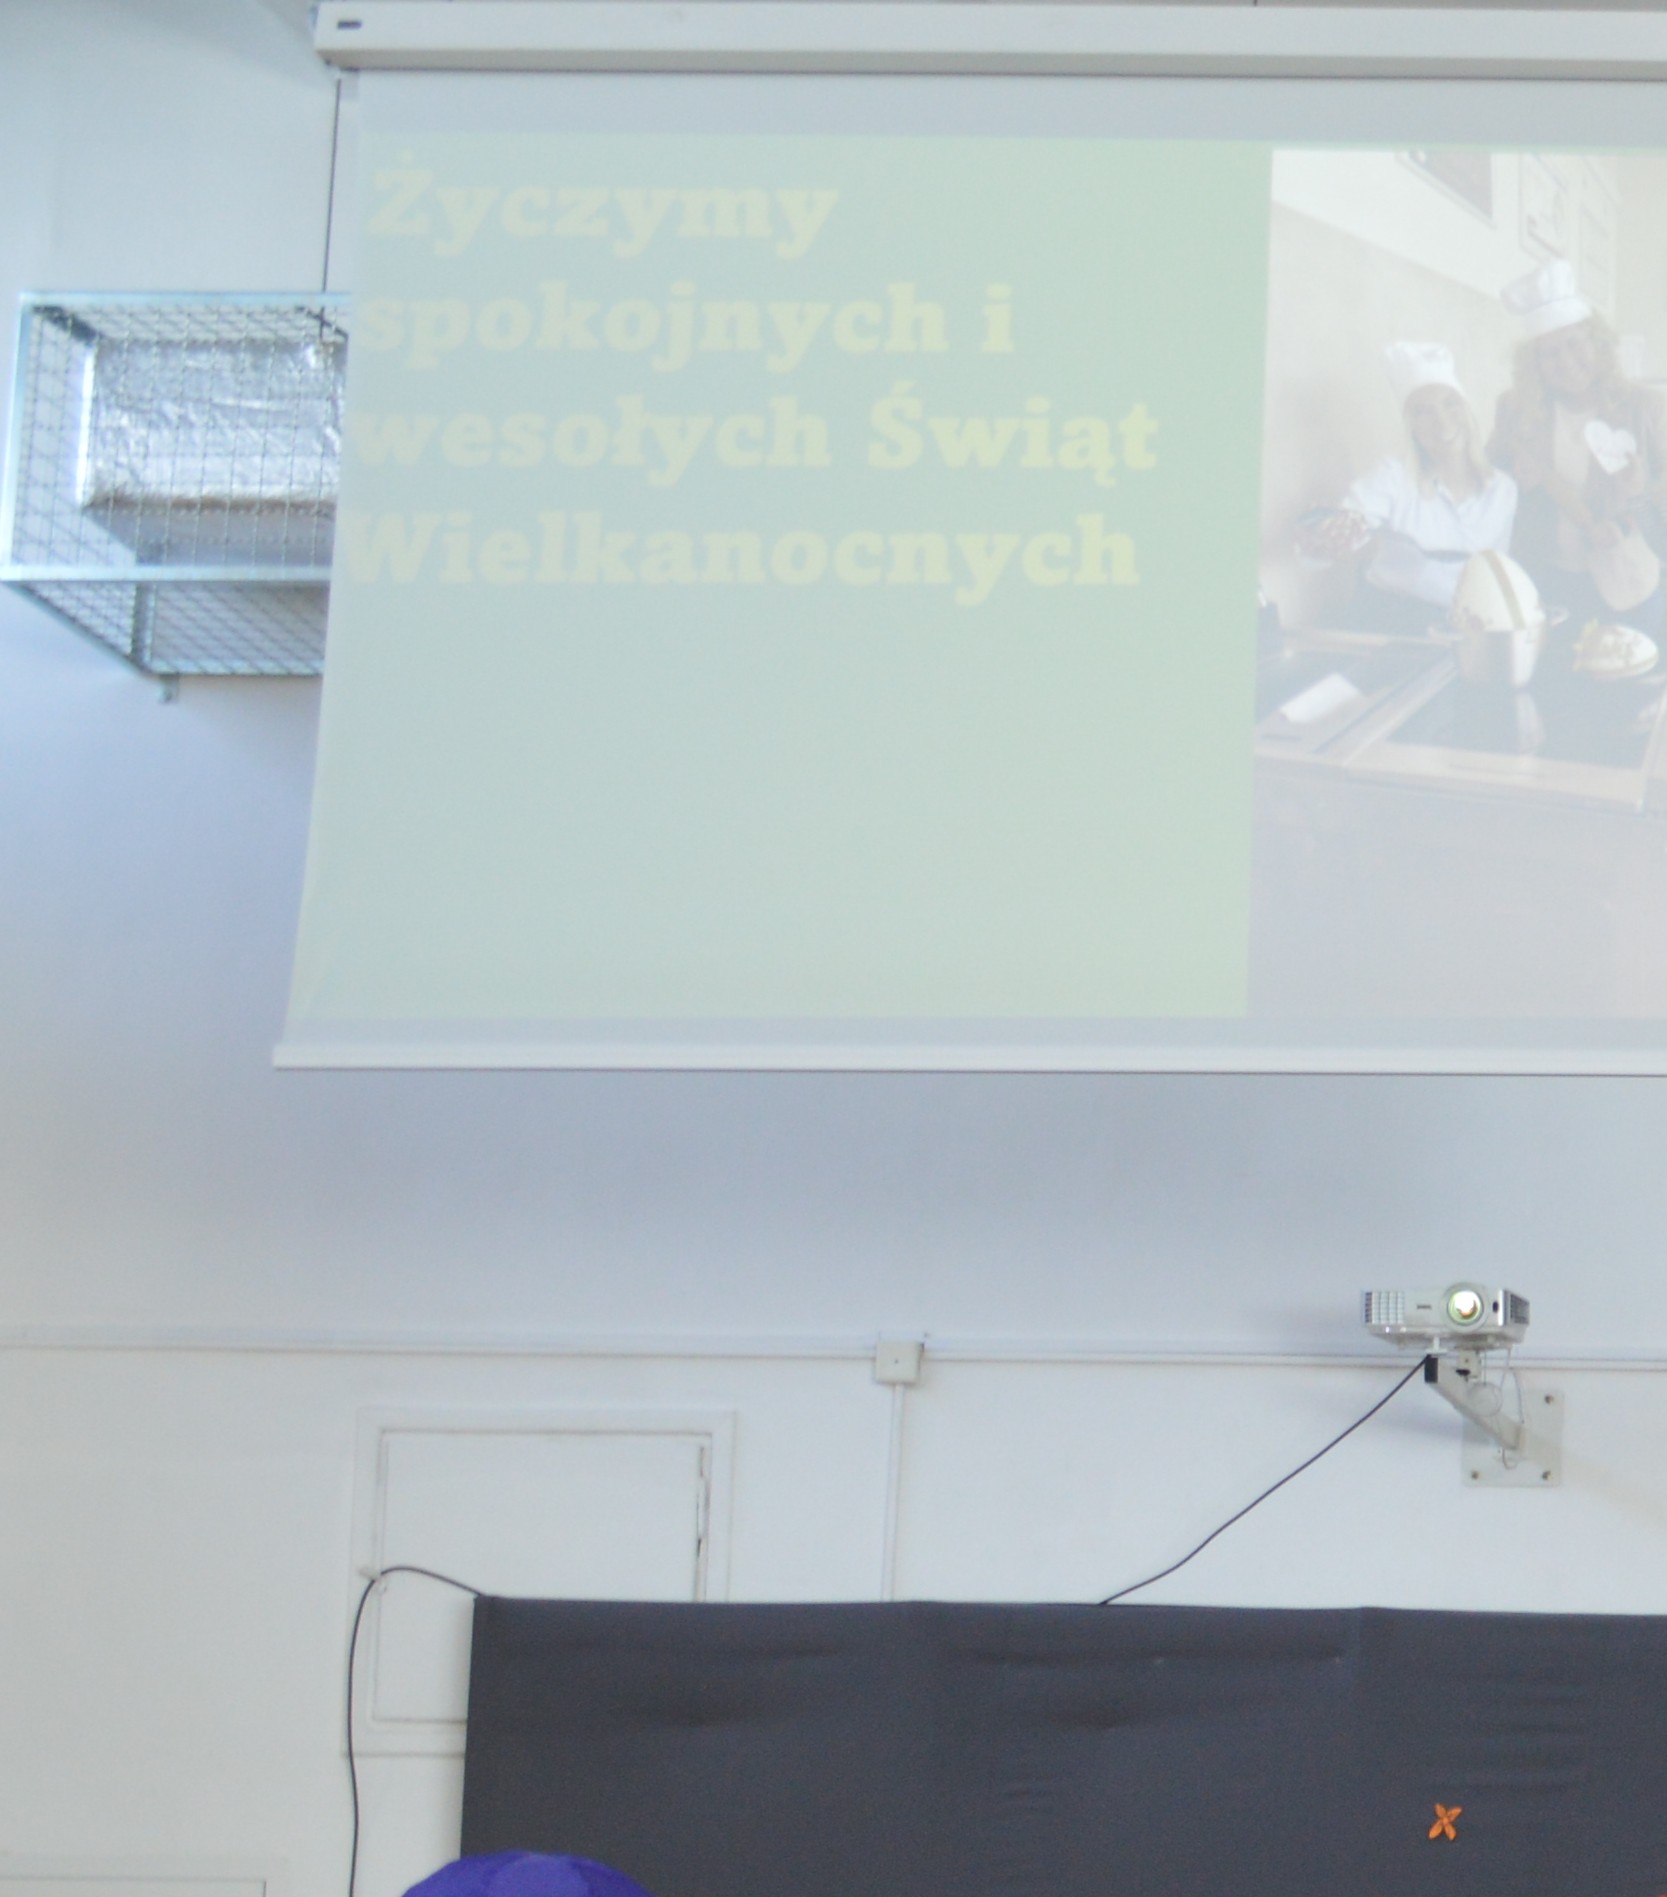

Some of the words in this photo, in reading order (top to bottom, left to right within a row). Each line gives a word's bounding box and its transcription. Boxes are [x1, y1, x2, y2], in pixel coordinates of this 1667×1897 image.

[366, 146, 840, 257] Życzymy
[358, 280, 950, 373] spokojnych
[981, 283, 1017, 354] i
[351, 394, 832, 488] wesołych
[866, 380, 1161, 486] Świąt
[340, 510, 1142, 606] Wielkanocnych
